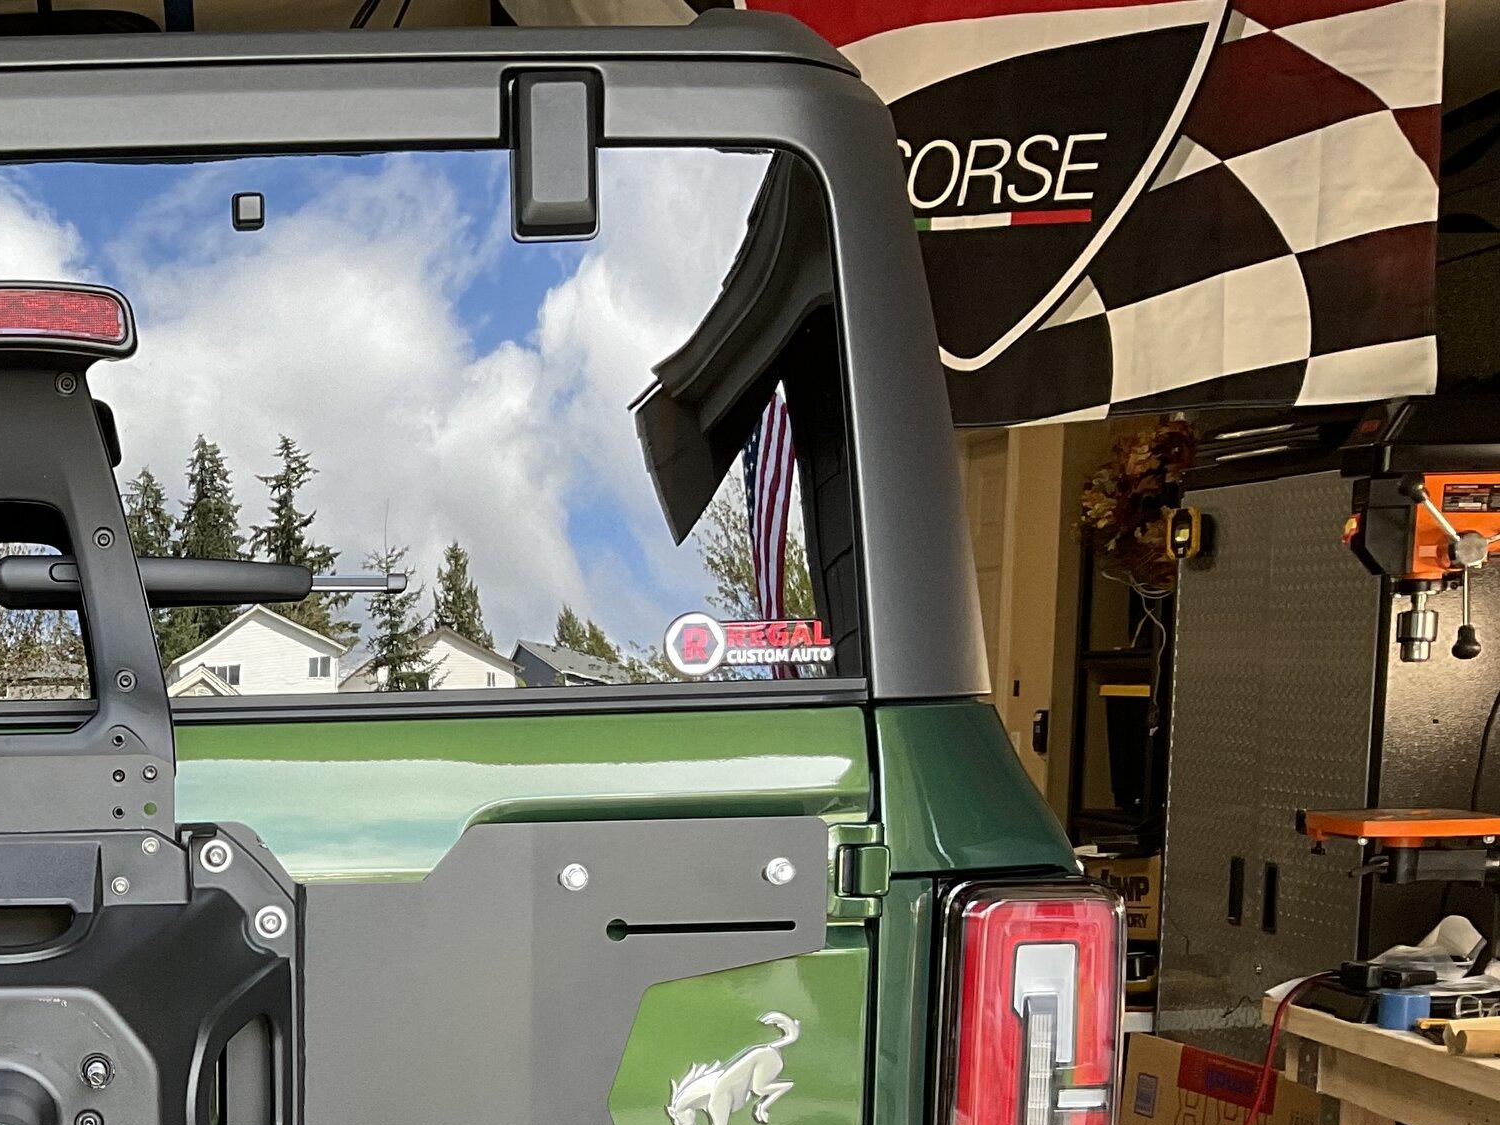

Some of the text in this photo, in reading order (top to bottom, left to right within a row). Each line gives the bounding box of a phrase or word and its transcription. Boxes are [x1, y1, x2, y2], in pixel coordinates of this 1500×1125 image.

[897, 132, 1107, 209] ORSE
[727, 621, 830, 646] REGAL
[726, 647, 834, 664] CUSTOM AUTO
